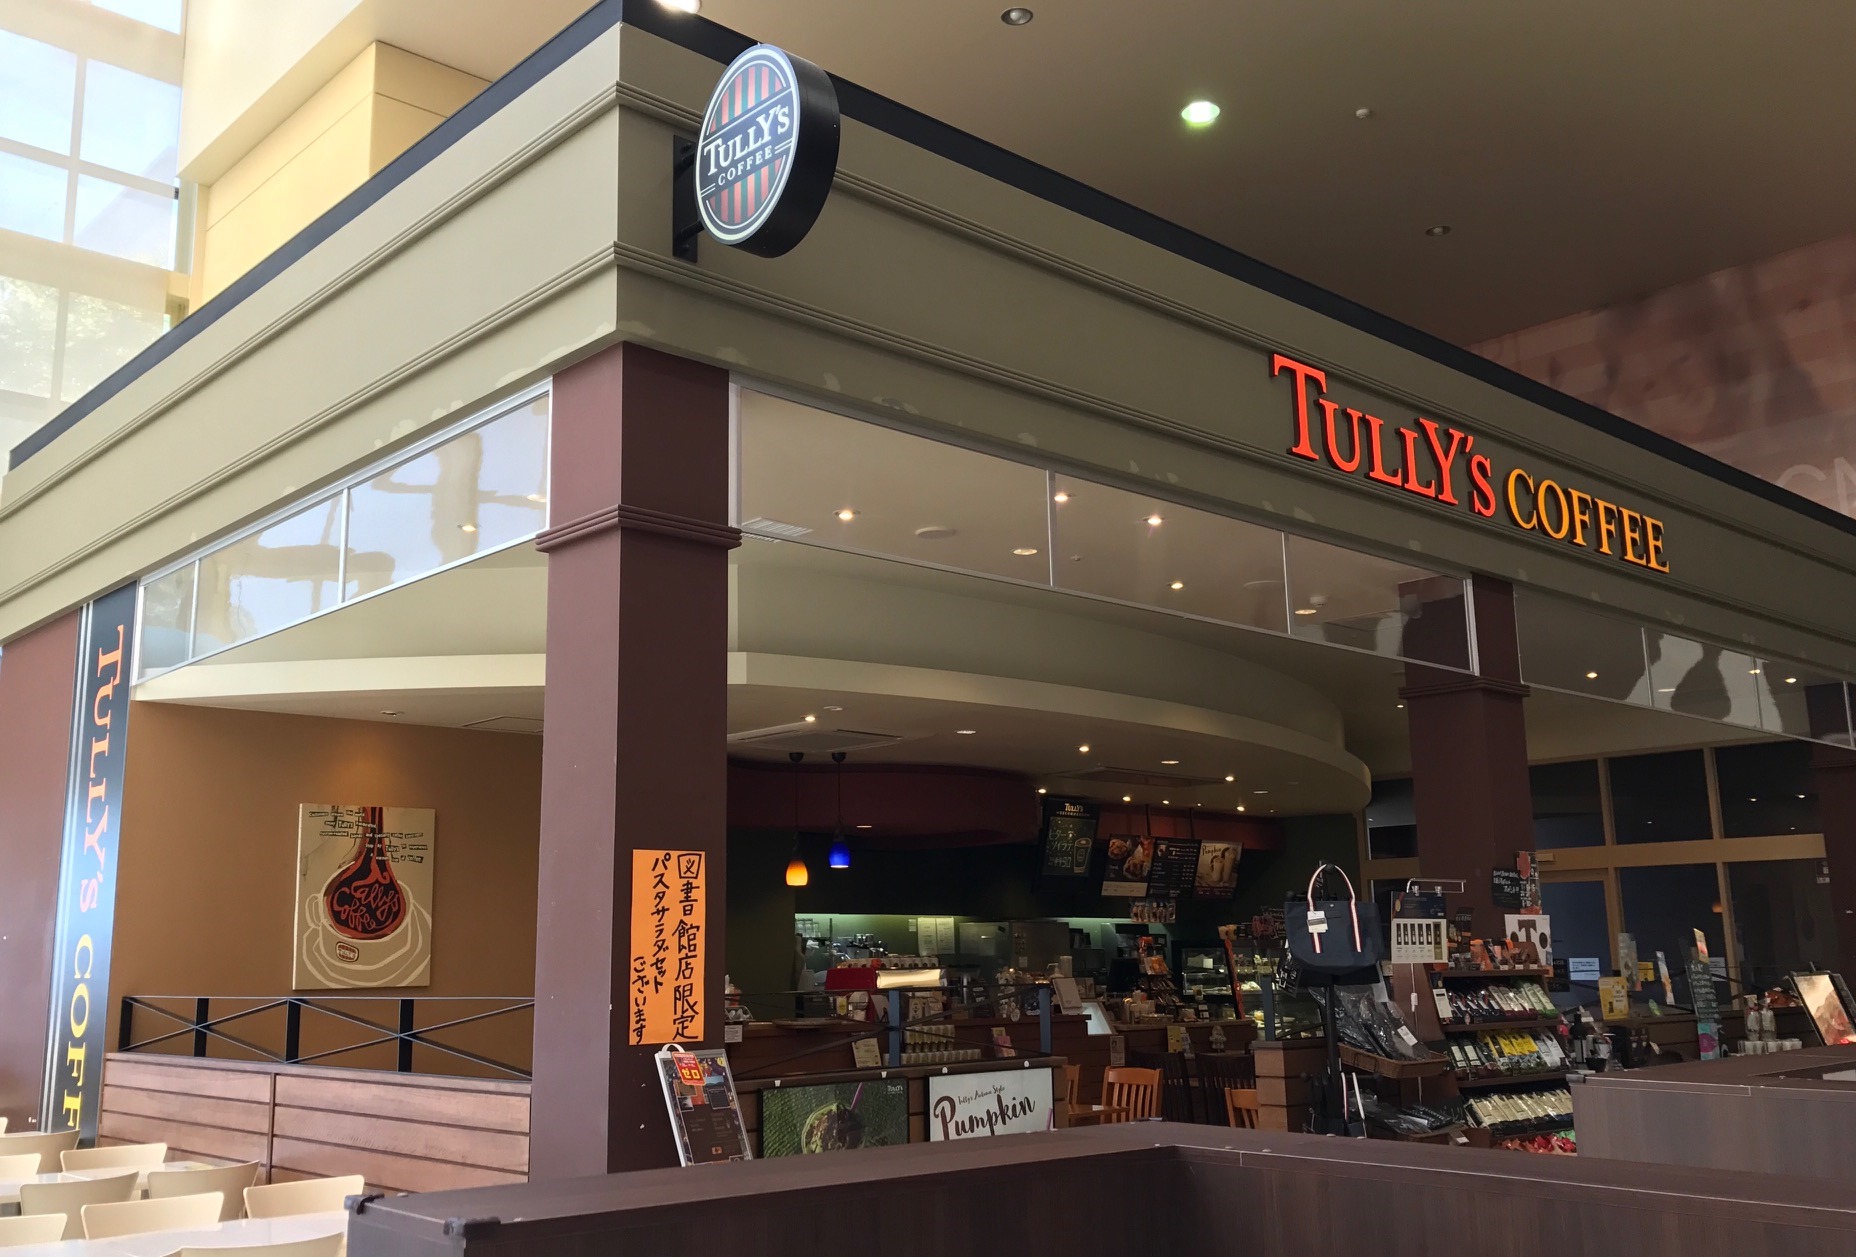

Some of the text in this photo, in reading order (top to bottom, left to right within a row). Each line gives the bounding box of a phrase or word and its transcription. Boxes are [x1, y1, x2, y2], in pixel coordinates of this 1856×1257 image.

[703, 103, 790, 176] TULLY'S
[717, 144, 773, 186] COFFEE
[1270, 353, 1497, 518] TULLY'S
[1506, 467, 1670, 574] COFFEE
[80, 624, 125, 913] TULLY'S
[650, 852, 671, 994] パスタサラダセット
[672, 852, 702, 1041] 図書館店限定
[632, 956, 650, 1045] ございます
[681, 1068, 701, 1079] ゼロ
[933, 1094, 1036, 1141] Pumpkin
